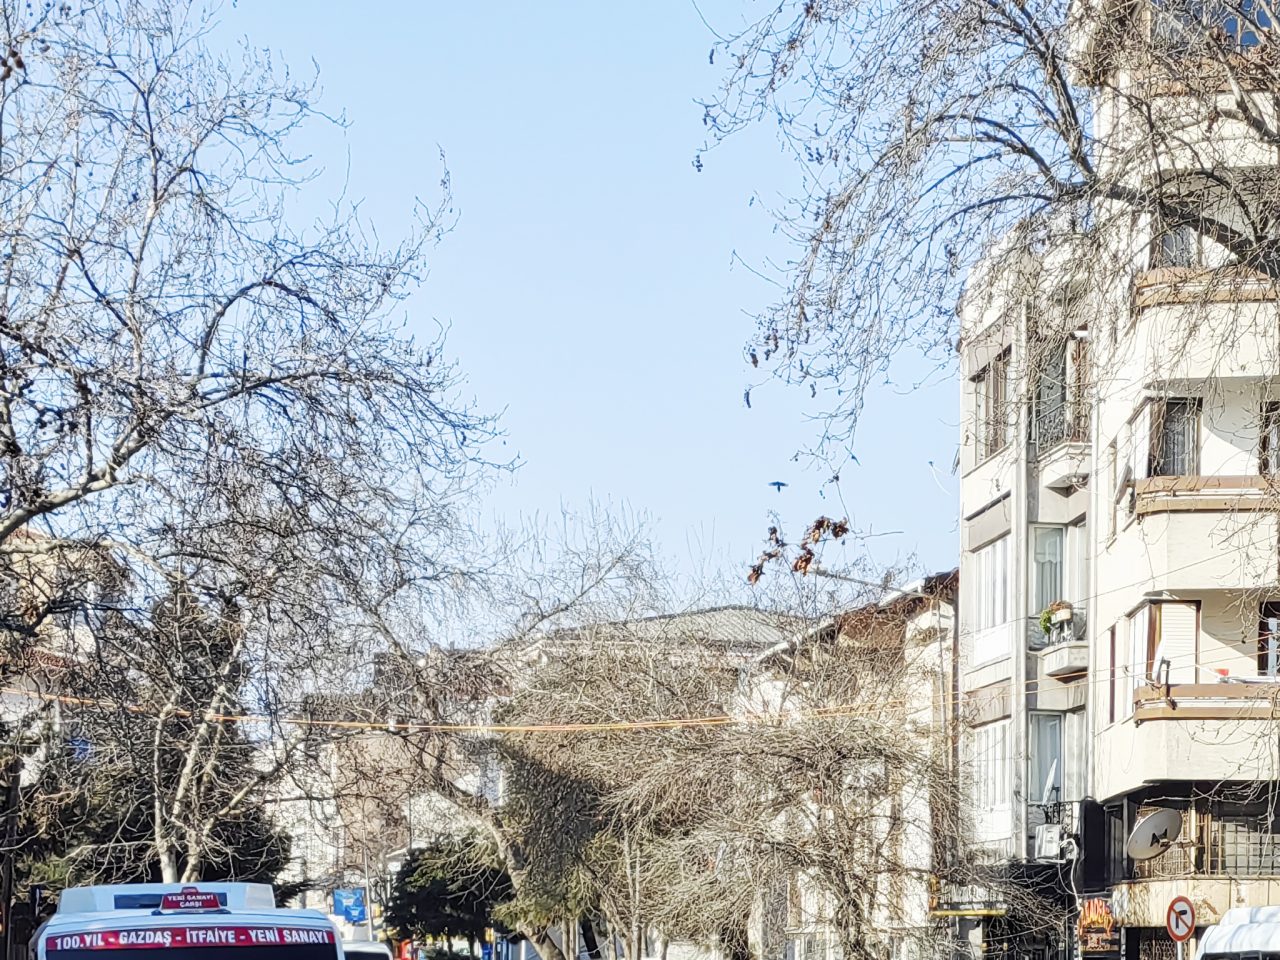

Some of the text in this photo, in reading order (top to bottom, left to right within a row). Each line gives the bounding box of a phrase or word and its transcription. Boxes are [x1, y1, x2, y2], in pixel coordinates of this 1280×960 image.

[55, 933, 105, 950] 100.YIL
[119, 930, 172, 947] GAZDAŞ
[186, 928, 236, 944] İTFAİYE
[248, 927, 280, 943] YENİ
[283, 928, 329, 945] SANAYİ
